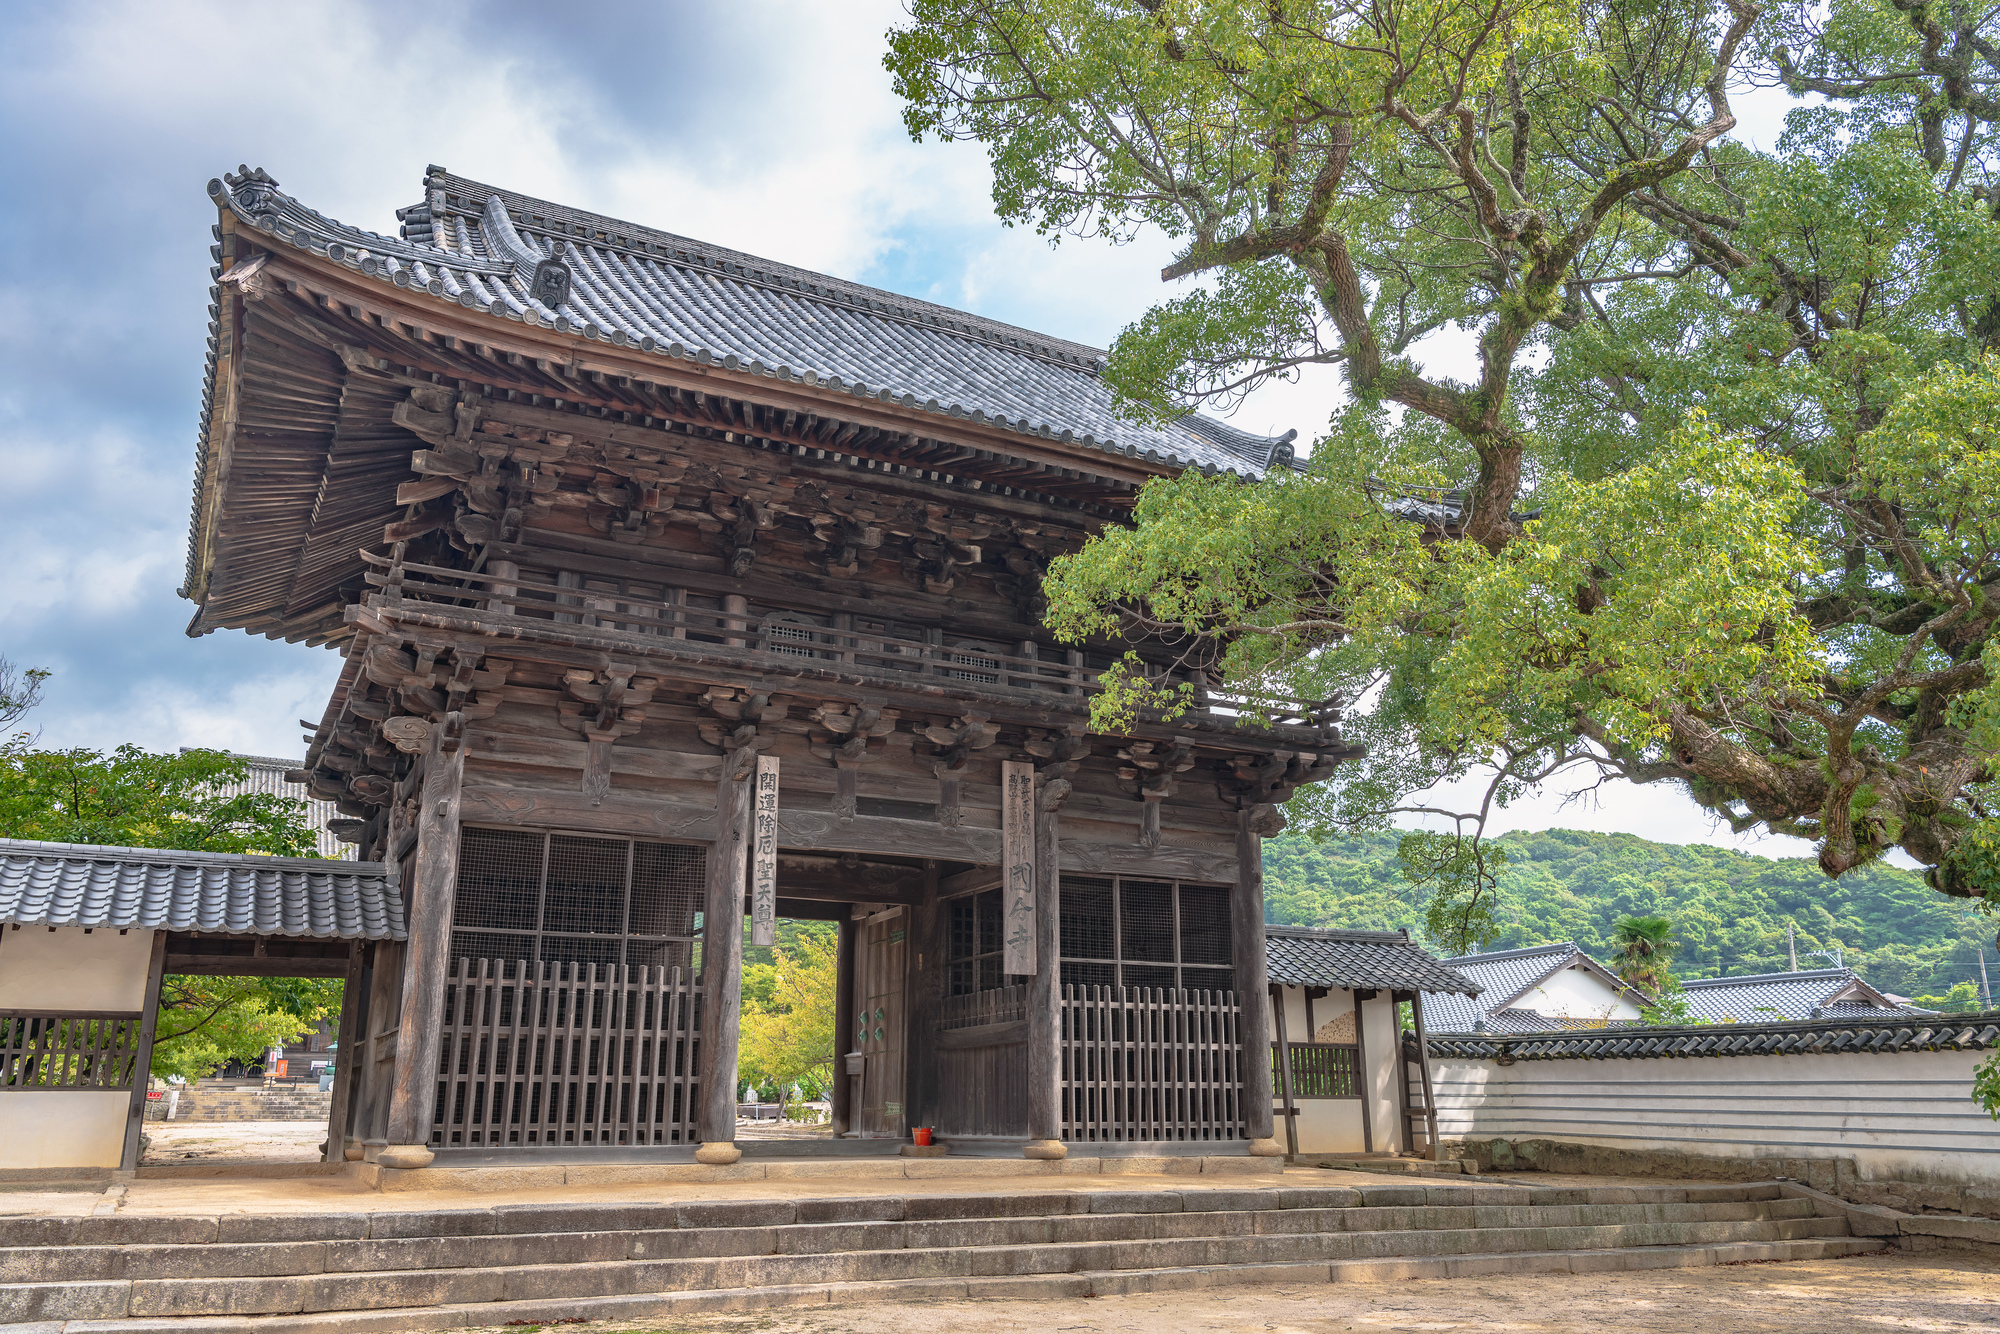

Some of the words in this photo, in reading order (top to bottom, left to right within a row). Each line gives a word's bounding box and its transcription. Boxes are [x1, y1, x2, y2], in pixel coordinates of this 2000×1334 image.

[754, 772, 777, 930] 開運除厄聖天尊
[1007, 862, 1034, 961] 國分寺
